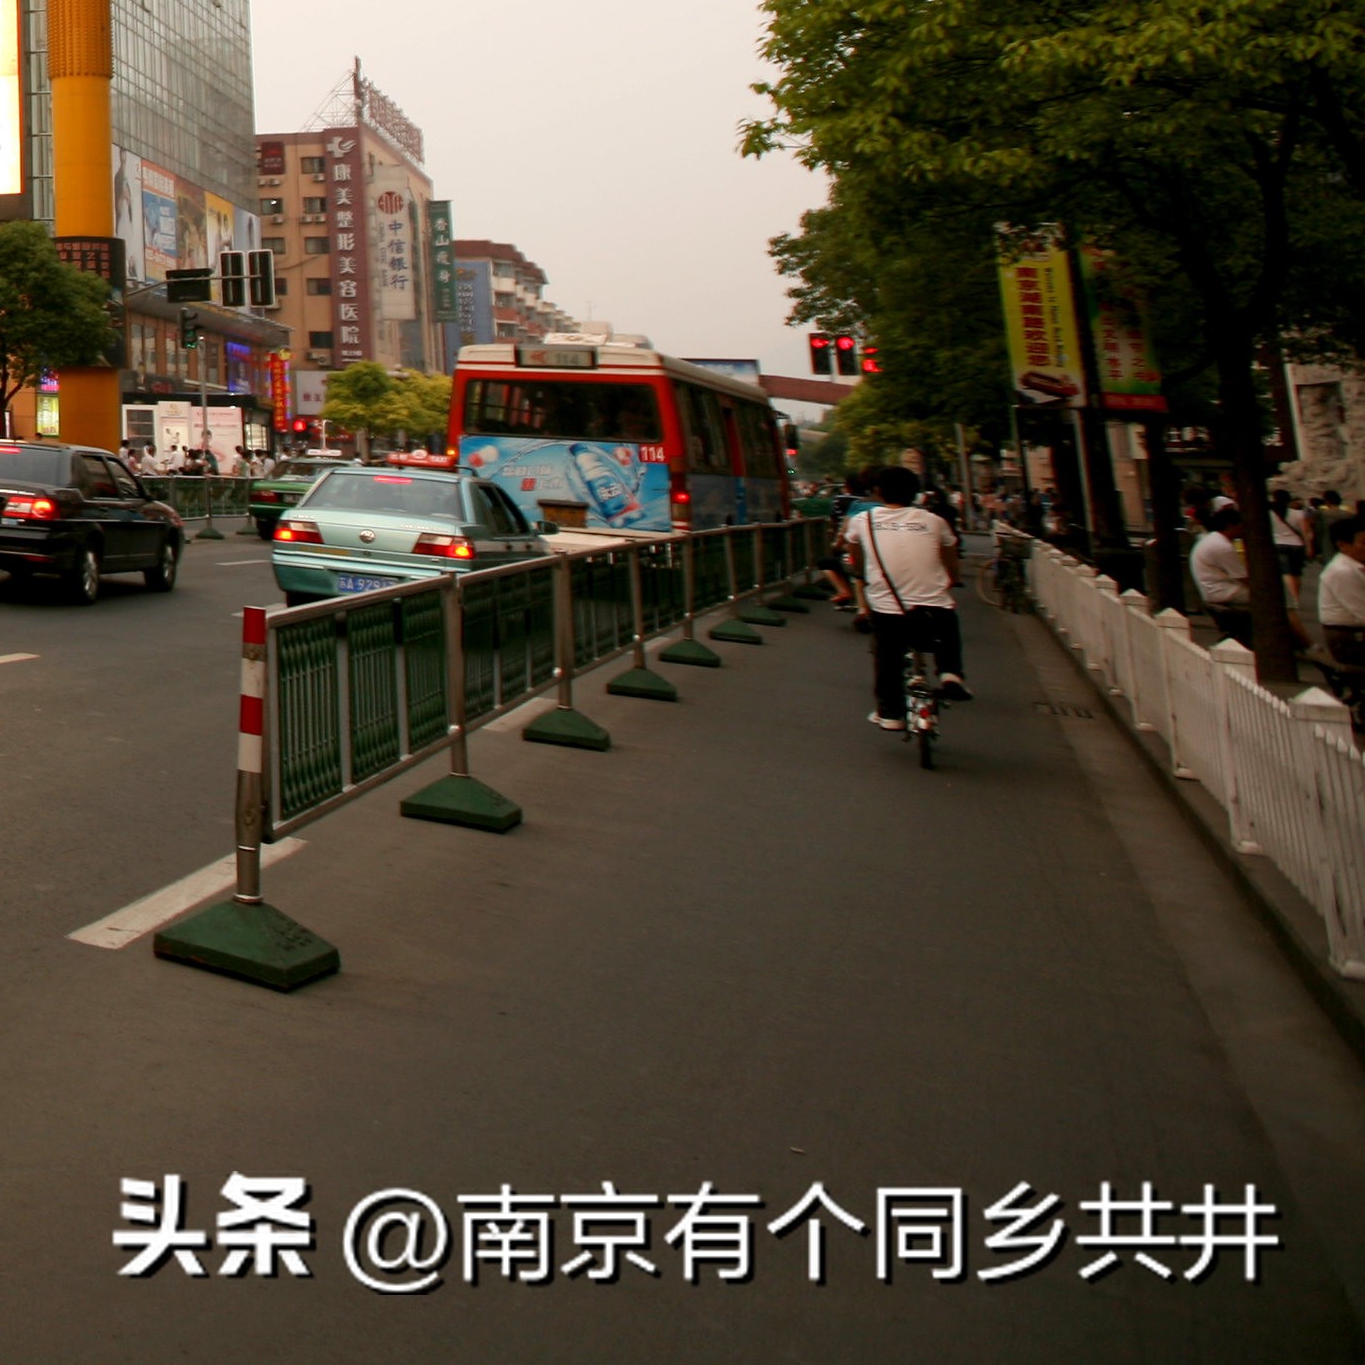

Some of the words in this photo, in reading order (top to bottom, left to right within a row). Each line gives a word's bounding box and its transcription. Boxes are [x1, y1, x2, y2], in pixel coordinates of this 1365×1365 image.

[332, 163, 360, 345] 康美整形美容医院
[387, 220, 409, 290] 中信银行
[641, 446, 666, 463] 114
